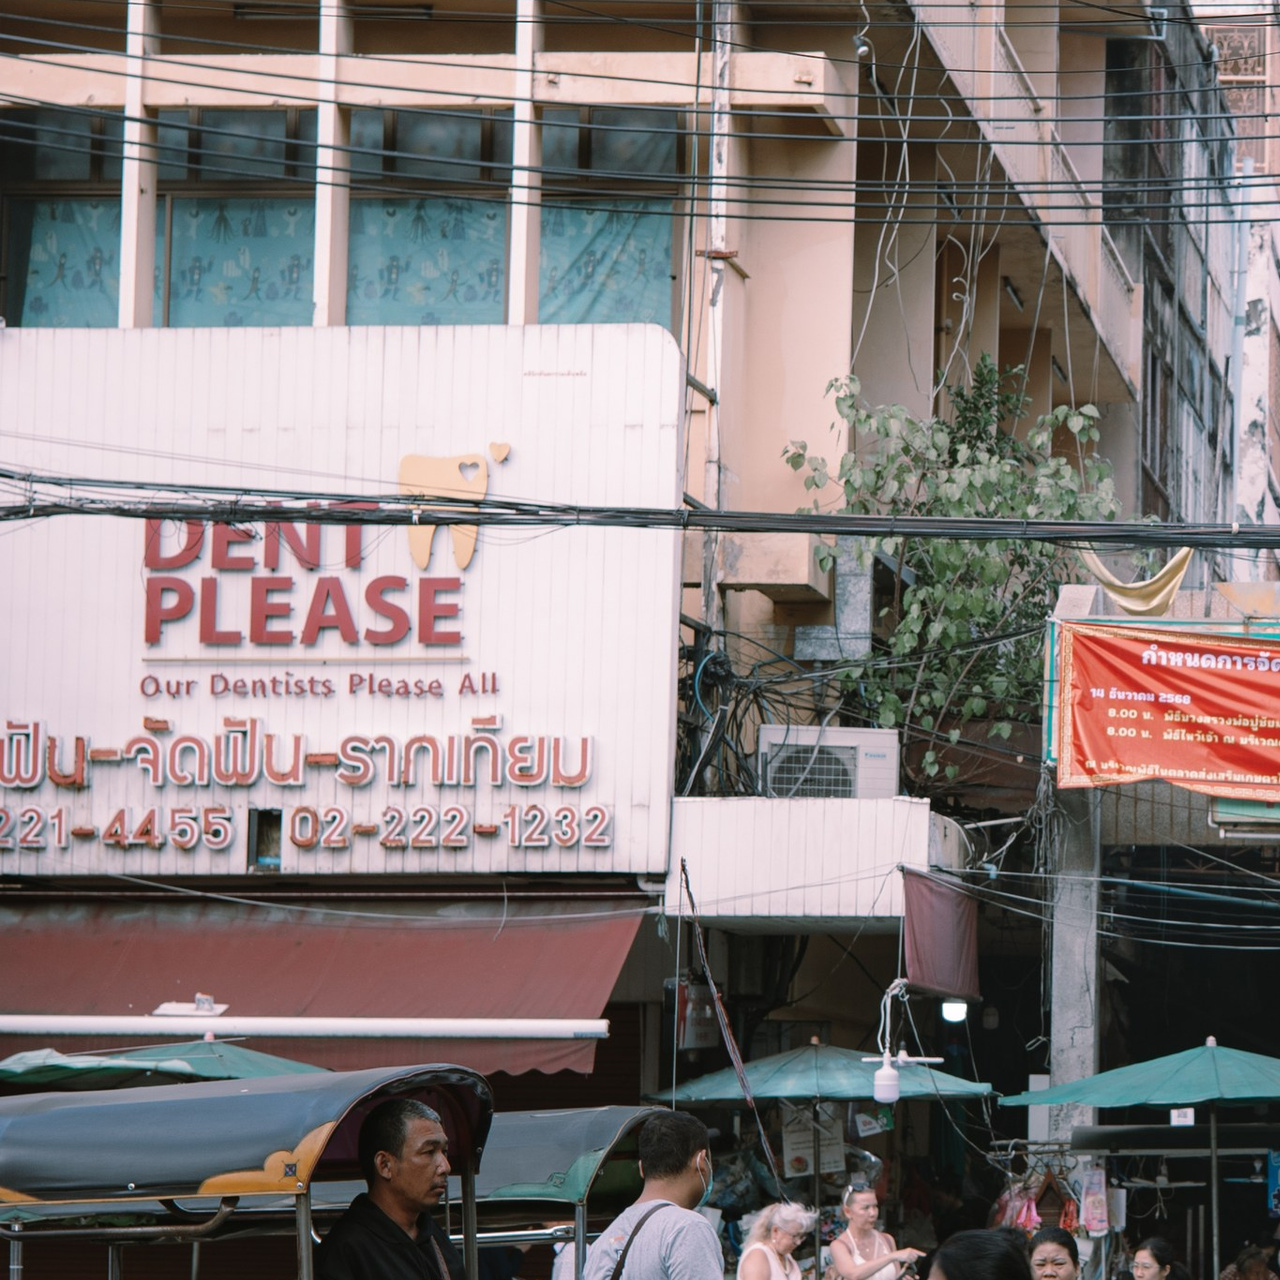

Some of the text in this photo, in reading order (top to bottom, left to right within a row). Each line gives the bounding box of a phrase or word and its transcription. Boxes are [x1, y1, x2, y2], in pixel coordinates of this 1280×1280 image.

[145, 500, 380, 570] DENT
[145, 576, 463, 645] PLEASE
[140, 671, 500, 699] Our Dentists Please All
[1090, 686, 1192, 705] 14 ธันวาคม 2568
[1108, 707, 1138, 719] 8.00
[1106, 726, 1137, 738] 8.00
[290, 805, 611, 850] 02-222-1232
